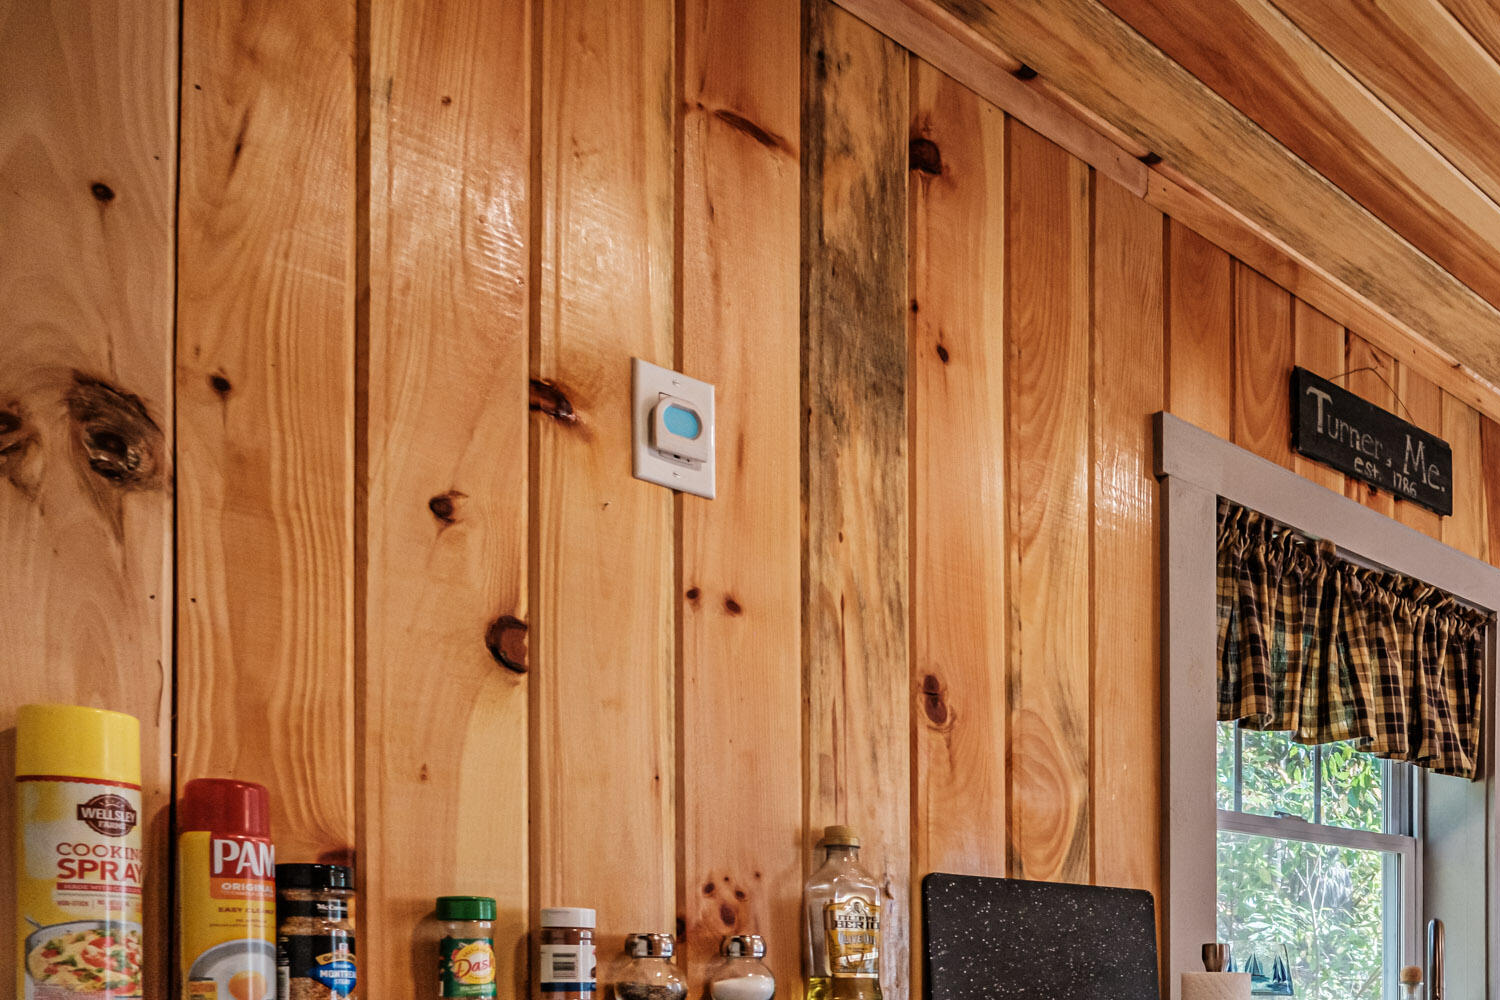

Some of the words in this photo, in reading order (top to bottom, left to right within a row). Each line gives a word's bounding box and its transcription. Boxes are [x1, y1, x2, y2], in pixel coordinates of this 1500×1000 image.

[1403, 434, 1445, 492] Me.
[1393, 472, 1417, 497] 1786
[81, 807, 136, 823] WELLSLEY
[56, 842, 142, 860] COOKIN
[214, 839, 276, 878] PAM
